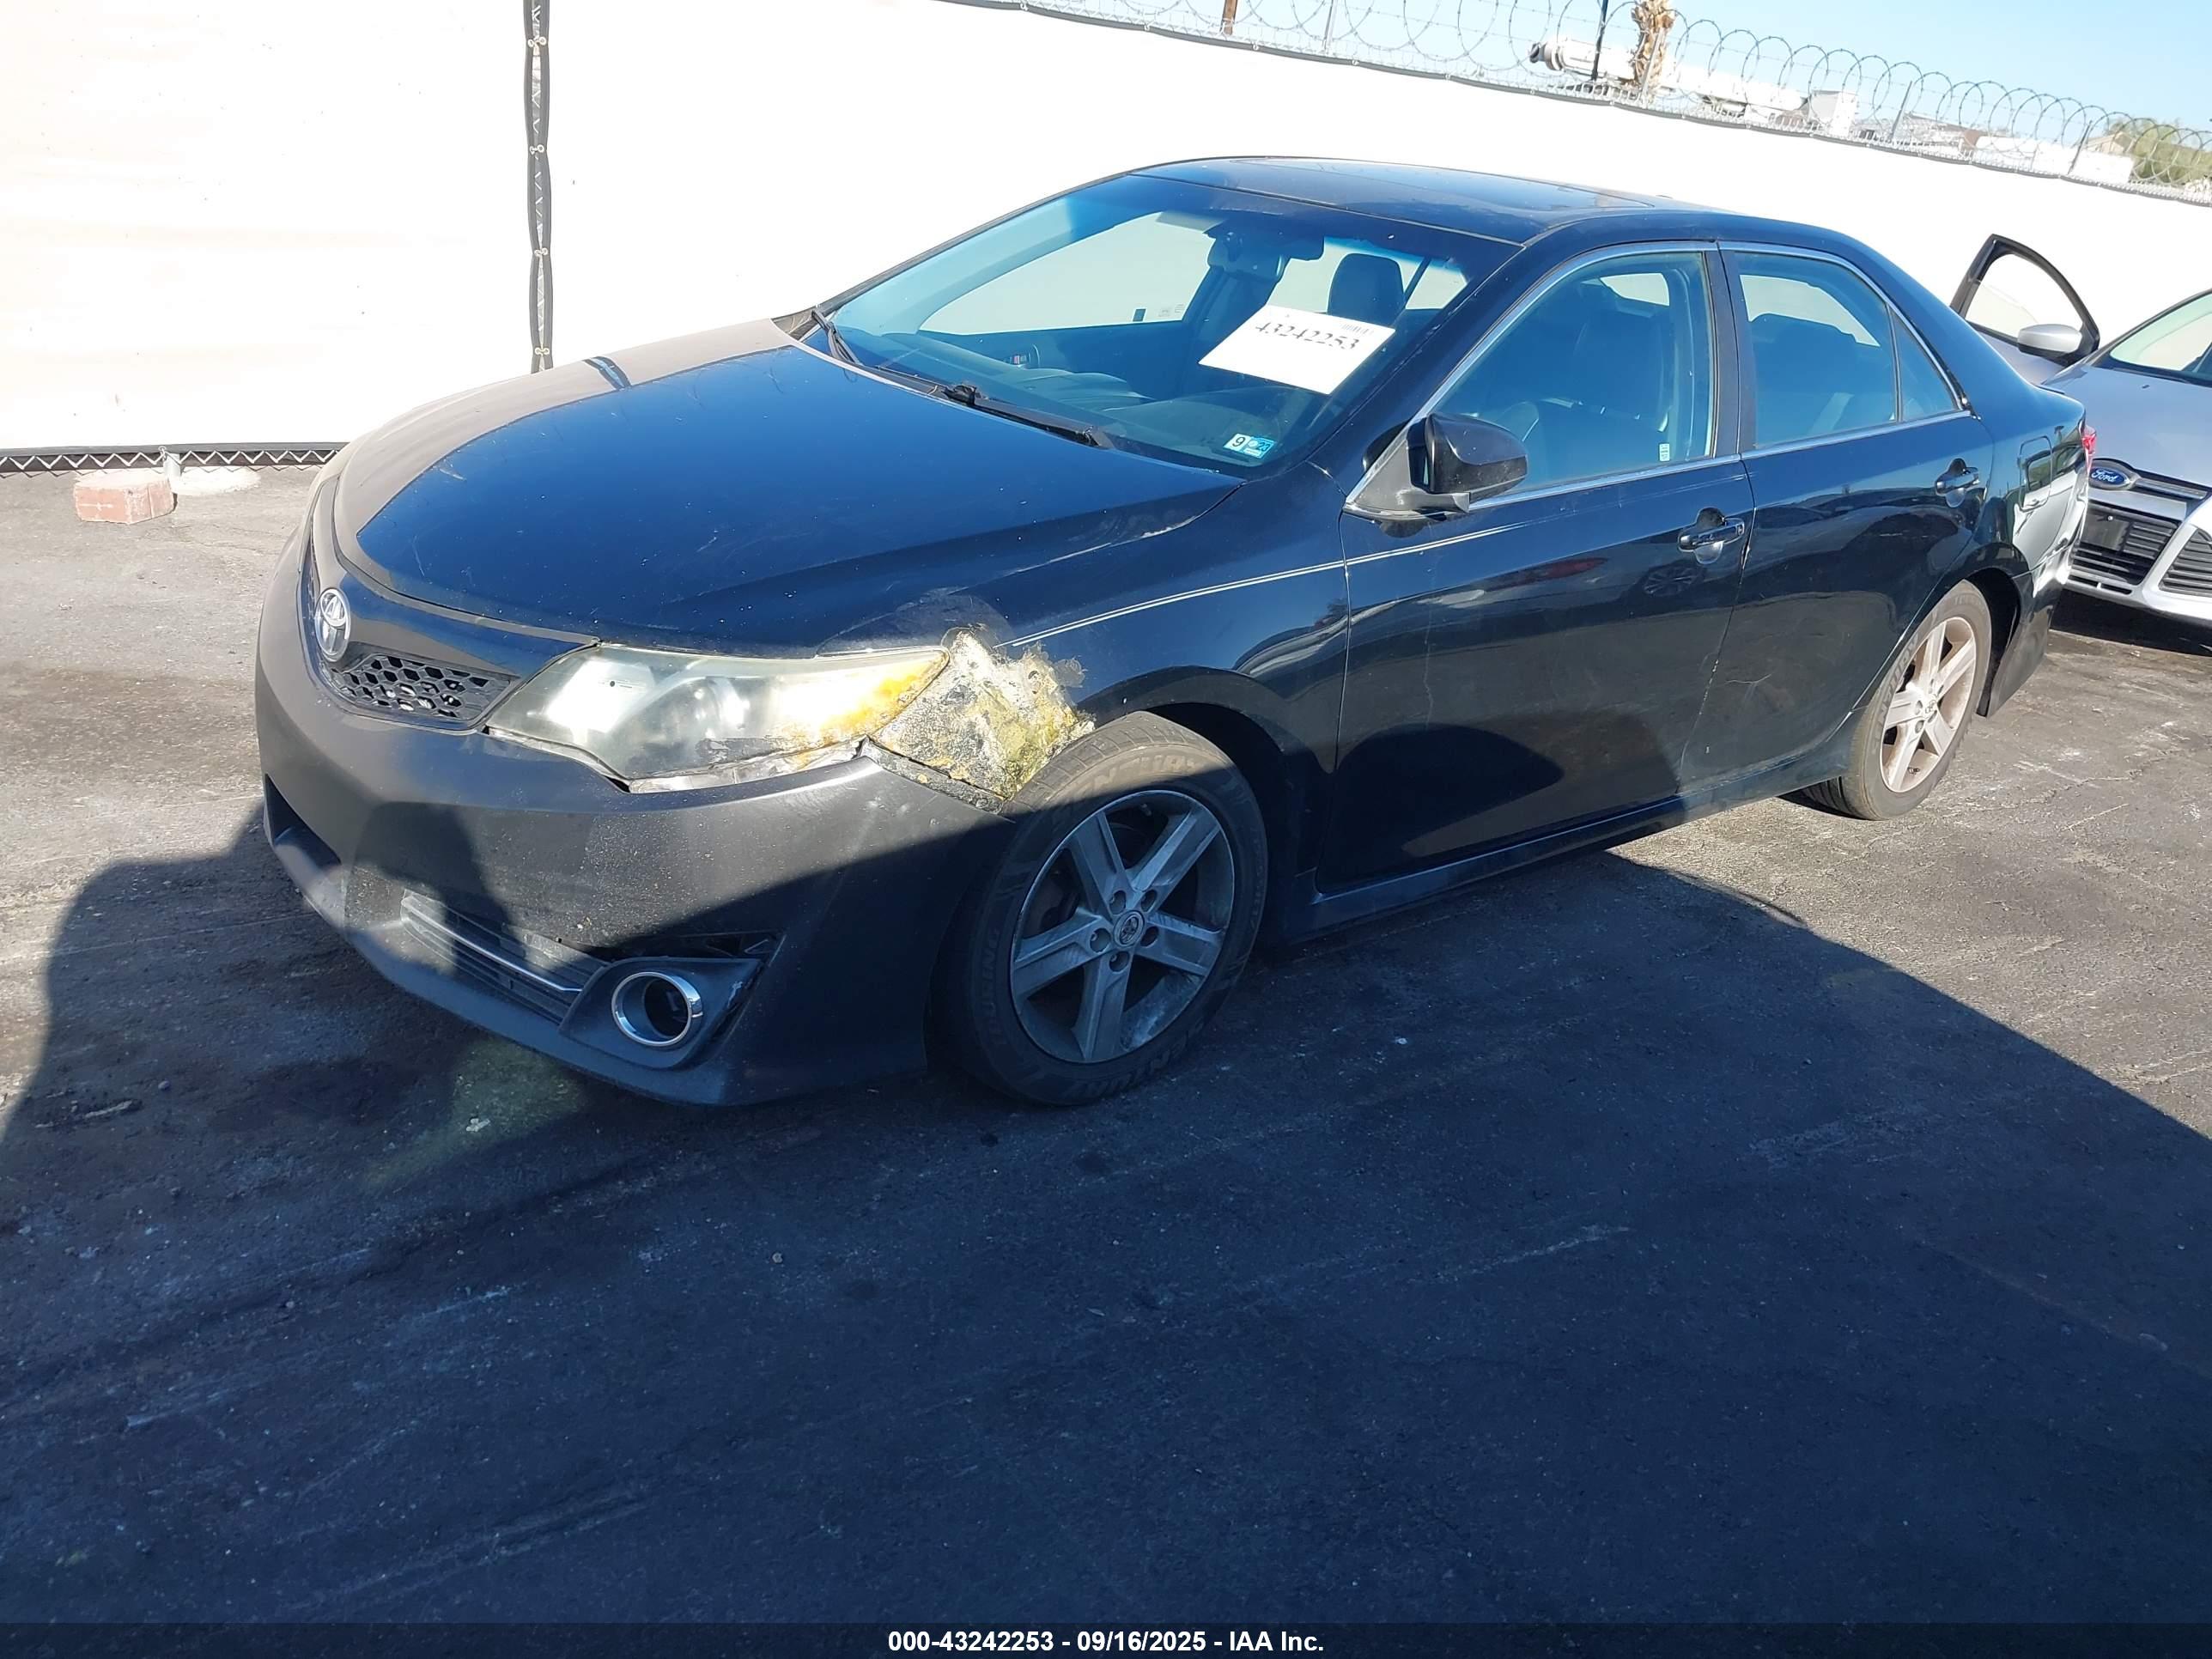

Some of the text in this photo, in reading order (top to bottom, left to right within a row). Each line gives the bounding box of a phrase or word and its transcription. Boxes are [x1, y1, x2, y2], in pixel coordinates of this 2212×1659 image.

[1255, 321, 1360, 349] 43242253
[1231, 436, 1246, 447] 9
[2091, 469, 2119, 483] Ford
